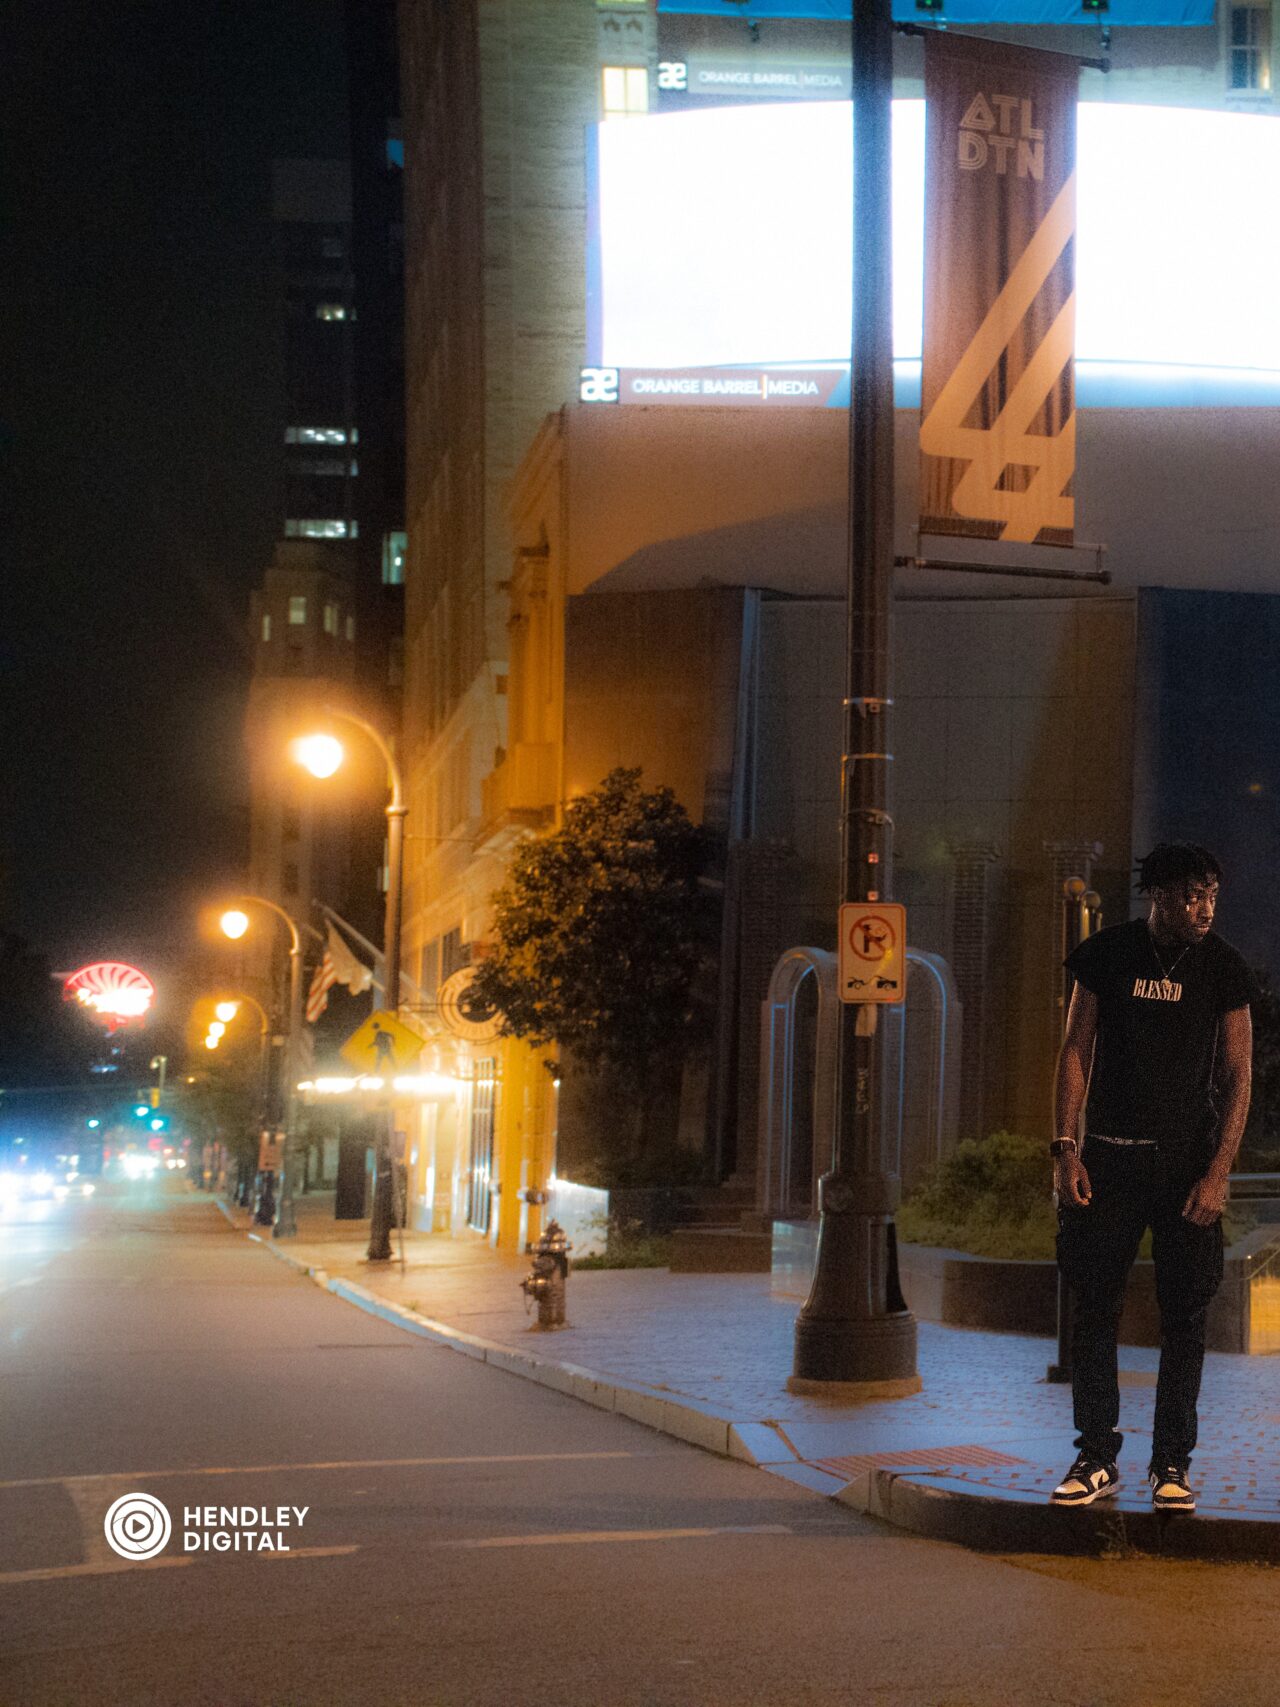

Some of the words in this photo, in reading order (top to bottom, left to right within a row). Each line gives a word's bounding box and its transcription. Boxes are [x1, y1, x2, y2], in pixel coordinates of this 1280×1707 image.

[700, 70, 749, 84] ORANGE
[753, 71, 799, 86] BARREL
[804, 73, 843, 87] MEDIA
[960, 91, 1044, 139] ATL
[958, 130, 1044, 181] DTN
[631, 379, 700, 394] ORANGE
[703, 379, 762, 395] BARREL
[768, 380, 819, 395] MEDIA
[1132, 978, 1182, 1001] BLESSED
